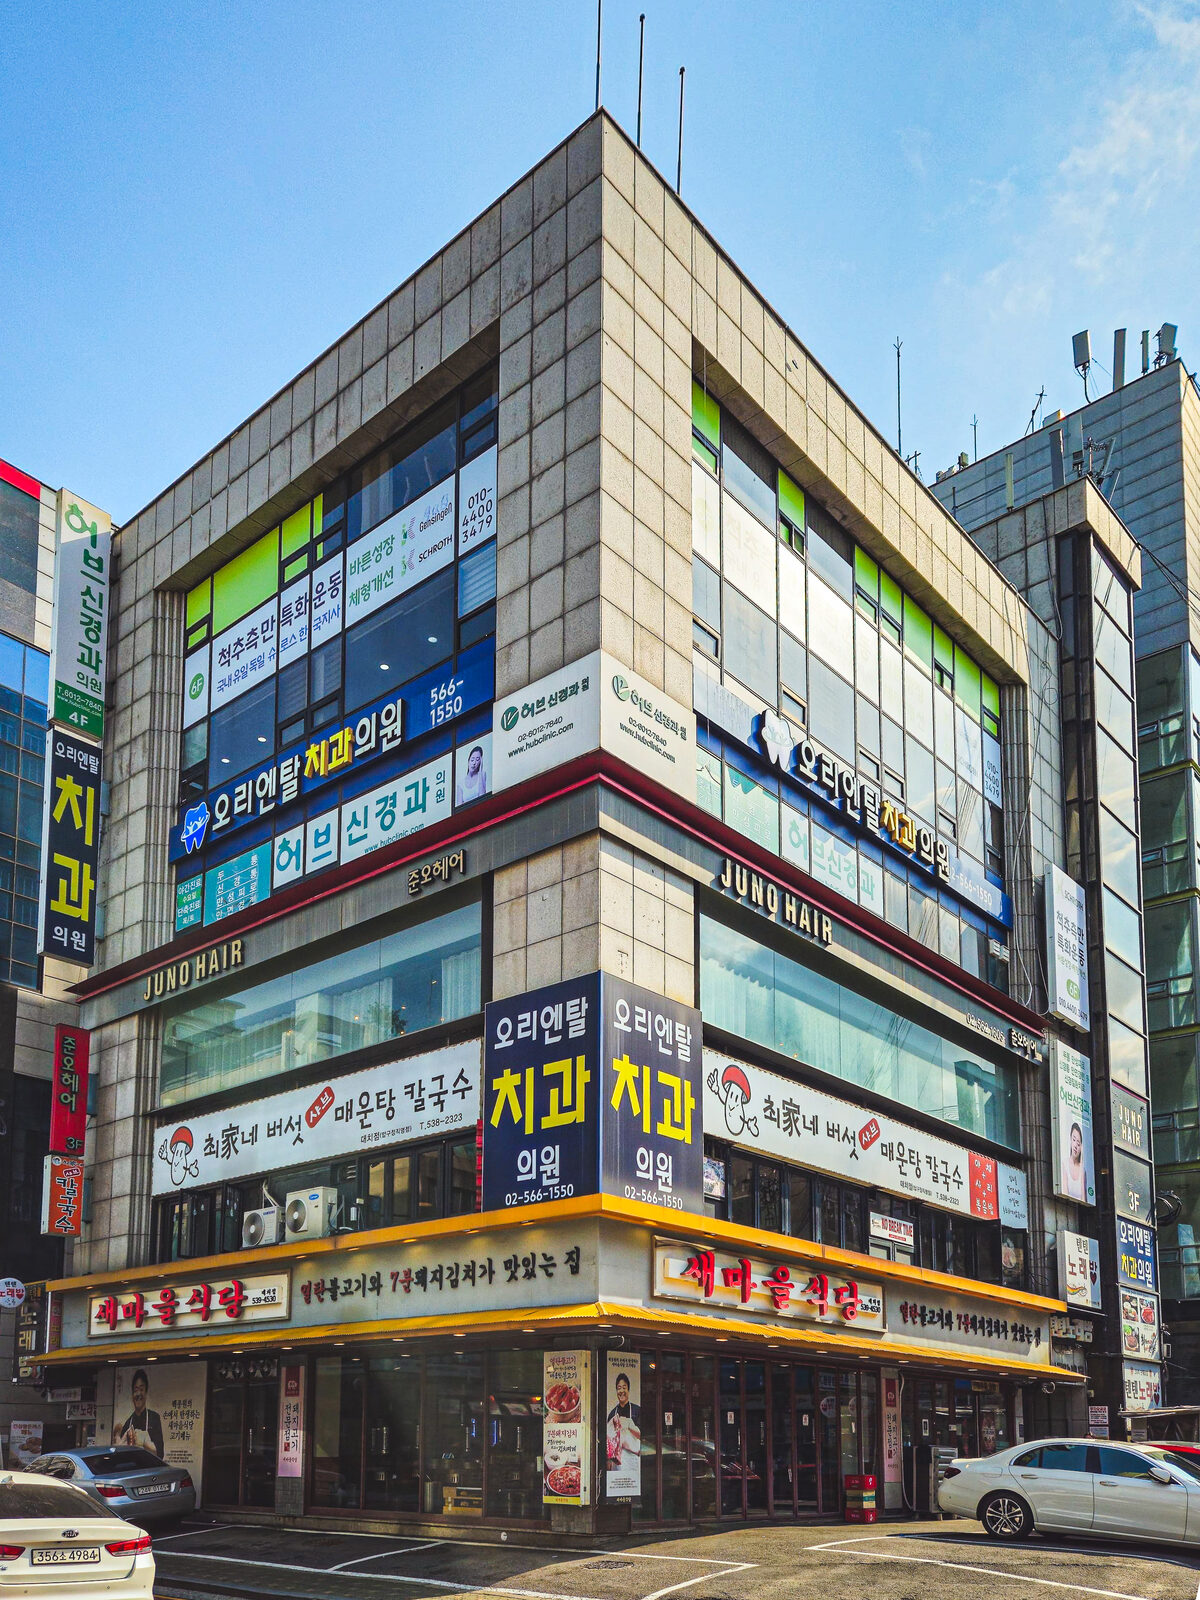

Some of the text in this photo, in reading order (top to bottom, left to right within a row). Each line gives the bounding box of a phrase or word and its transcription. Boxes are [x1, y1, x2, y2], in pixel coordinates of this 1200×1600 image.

[462, 500, 492, 527] 4400
[468, 488, 492, 509] 010-
[462, 514, 492, 543] 3479
[418, 534, 452, 563] SCHROTH
[69, 711, 88, 726] 4F
[430, 696, 464, 728] 1550
[55, 741, 98, 775] 오리엔탈
[508, 722, 574, 758] www.hubclinic.com
[51, 775, 95, 923] 치과
[408, 849, 466, 897] 준오헤어
[721, 858, 778, 914] JUNO
[785, 892, 832, 945] HAIR
[54, 926, 86, 950] 의원
[144, 939, 243, 1001] JUNO HAIR
[494, 996, 588, 1049] 오리엔탈
[614, 998, 692, 1063] 오리엔탈
[60, 1036, 79, 1113] 준오헤어
[490, 1054, 591, 1135] 치과
[610, 1053, 696, 1145] 치과
[204, 1124, 258, 1161] 최家네
[267, 1115, 304, 1146] 버섯
[334, 1088, 396, 1129] 매운탕
[404, 1068, 473, 1113] 칼국수
[419, 1113, 463, 1131] T.538-2323
[1118, 1104, 1143, 1130] JUNO
[66, 1137, 83, 1150] 3F
[763, 1096, 819, 1138] 최家네
[827, 1120, 860, 1161] 버섯
[881, 1142, 922, 1179] 매운탕
[926, 1155, 964, 1193] 칼국수
[1122, 1123, 1141, 1147] HAIR
[517, 1144, 560, 1187] 의원
[636, 1146, 672, 1193] 의원
[56, 1177, 78, 1234] 칼국수
[506, 1183, 574, 1205] 02-566-1550
[625, 1185, 683, 1210] 02-566-1550
[1128, 1191, 1139, 1212] 3F
[1120, 1221, 1152, 1258] 오리엔탈
[503, 1252, 557, 1283] 맛있는
[565, 1246, 581, 1276] 집
[680, 1251, 863, 1321] 새마을식당
[95, 1280, 249, 1331] 새마을식당
